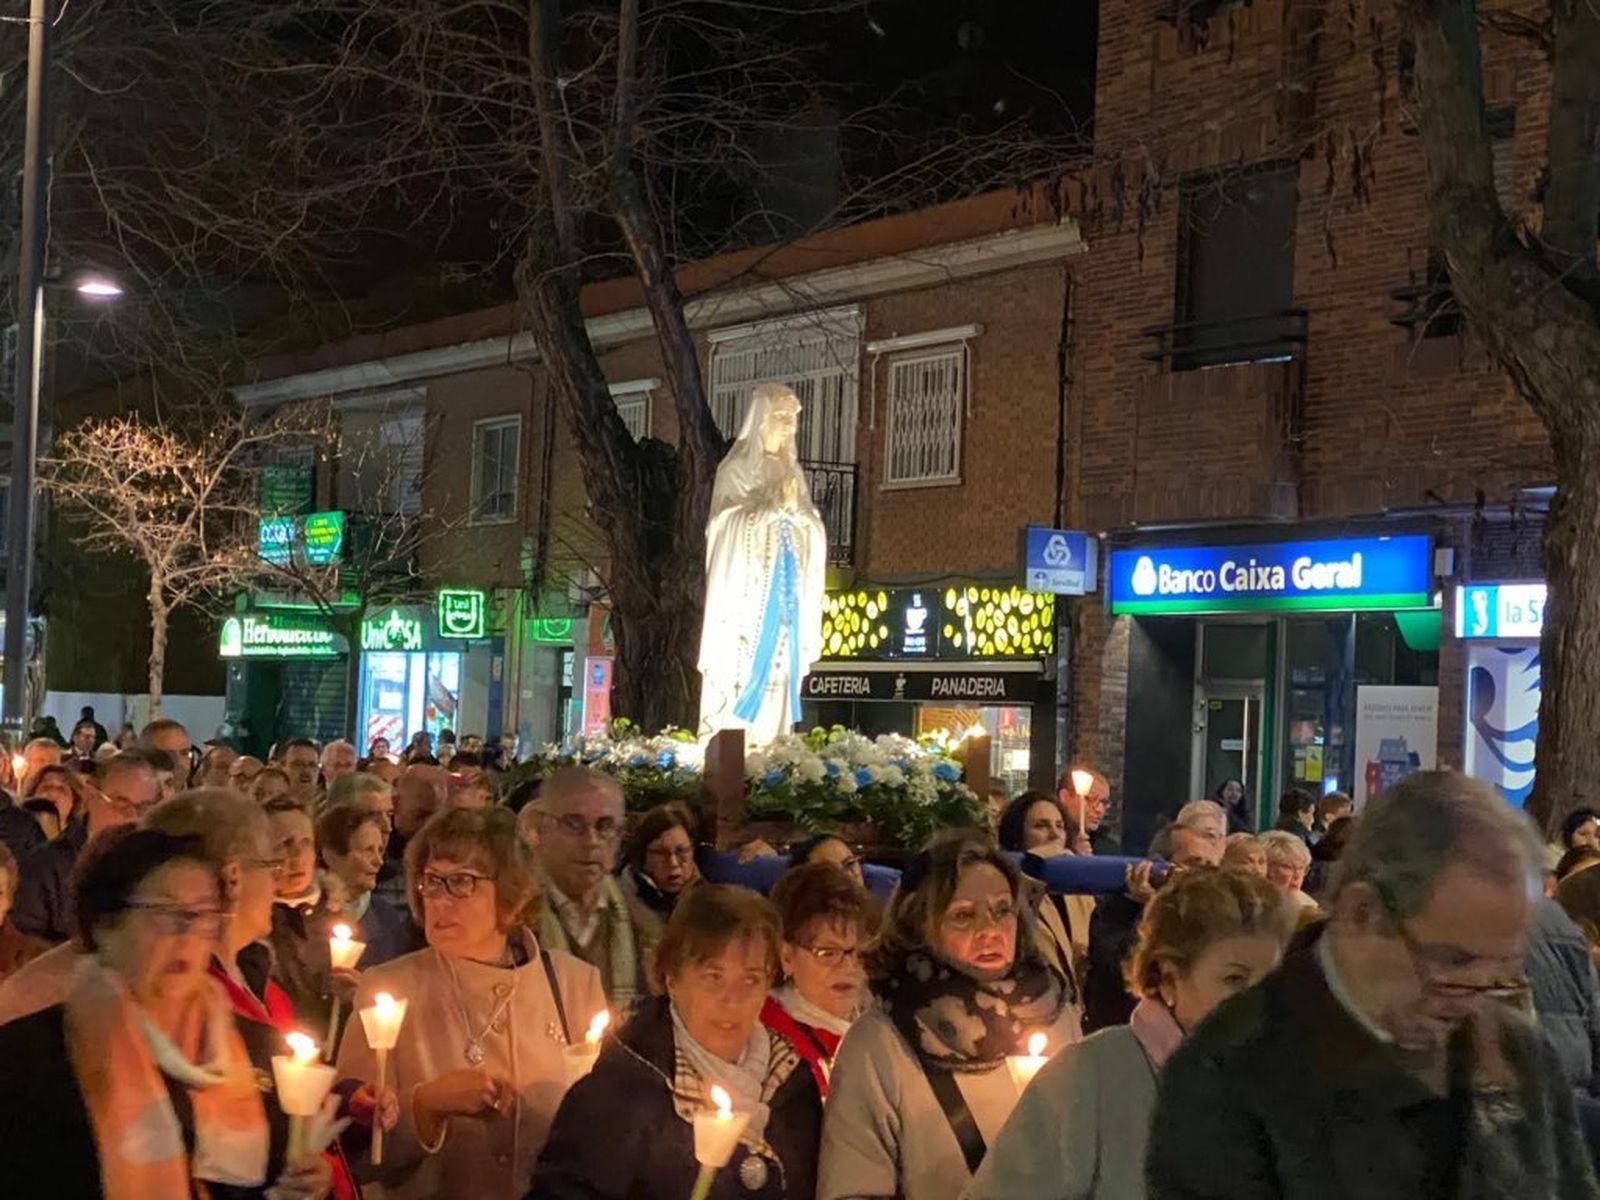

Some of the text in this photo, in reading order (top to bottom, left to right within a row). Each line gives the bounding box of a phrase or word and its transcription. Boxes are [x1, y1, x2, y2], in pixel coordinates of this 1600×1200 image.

[1158, 552, 1362, 594] Banco Caixa Geral
[1505, 599, 1545, 624] la S
[809, 676, 871, 695] CAFETERIA
[931, 676, 1006, 697] PANADERIA
